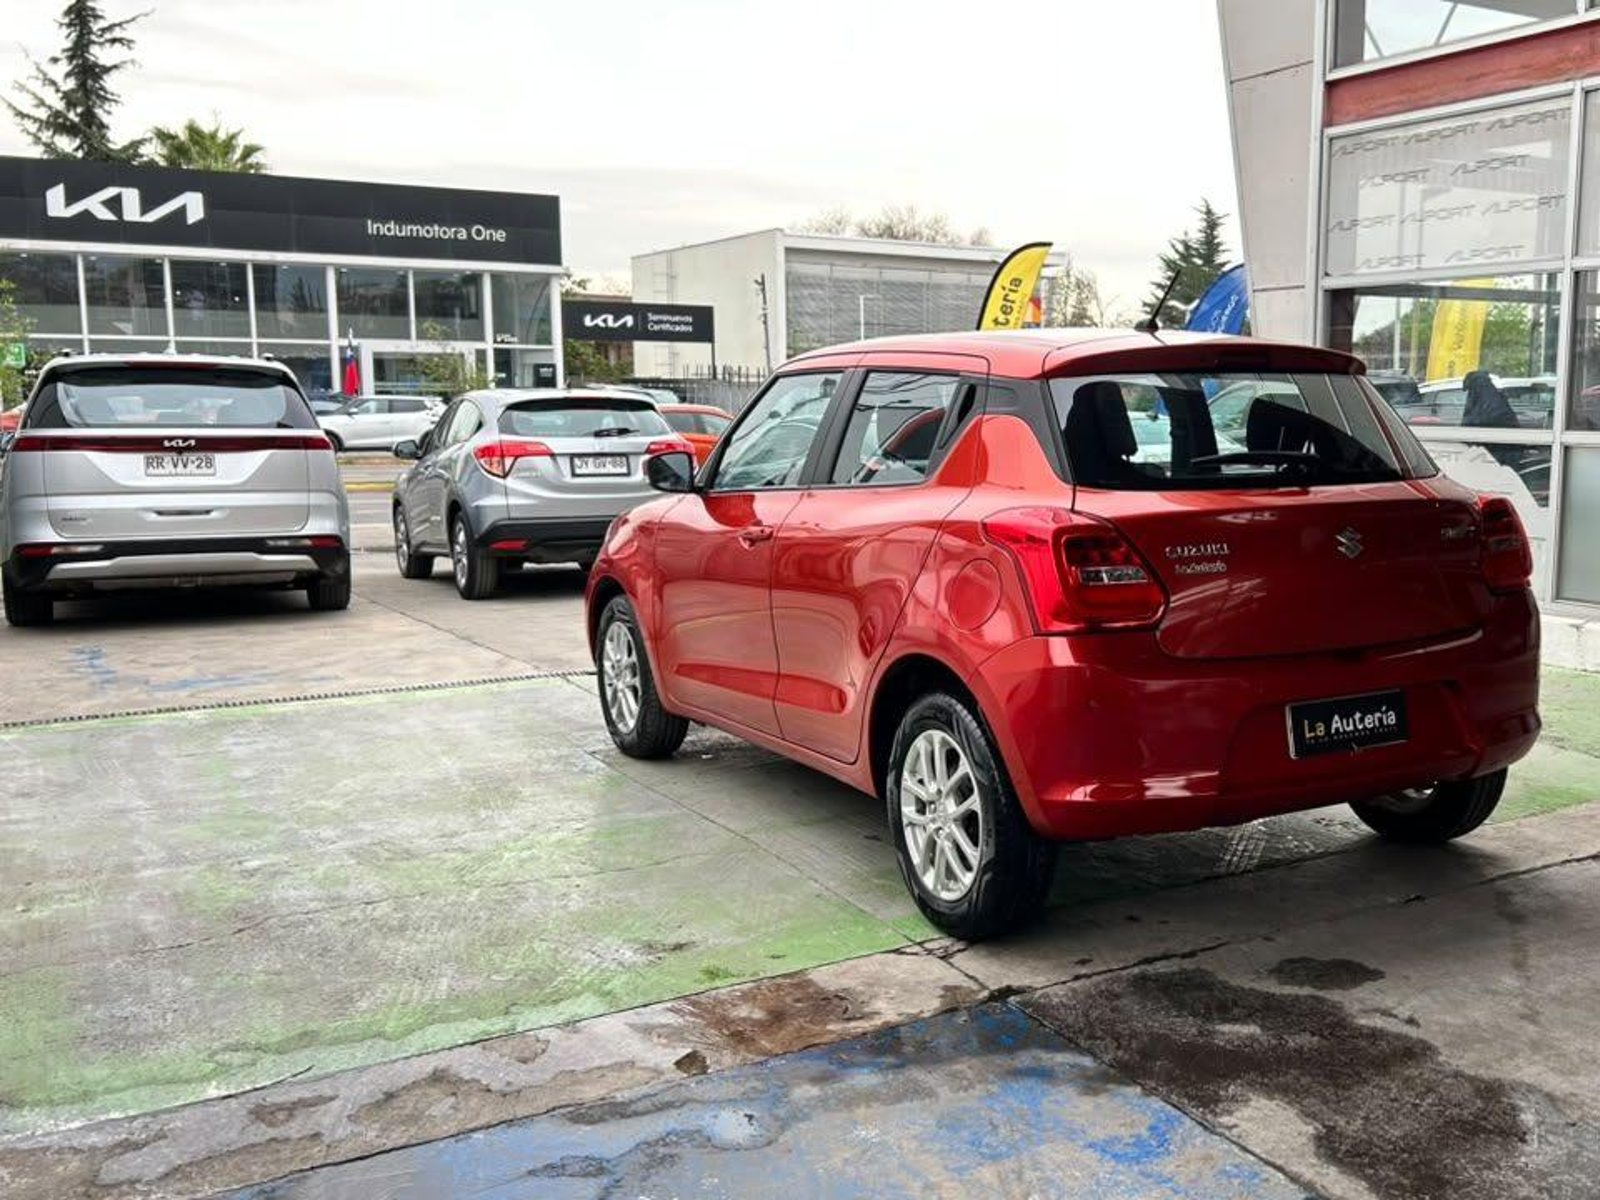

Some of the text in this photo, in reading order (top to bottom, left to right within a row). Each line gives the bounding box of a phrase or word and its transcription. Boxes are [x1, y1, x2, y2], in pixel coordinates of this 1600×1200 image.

[366, 218, 507, 242] Indumotora One
[1303, 719, 1326, 738] La
[1331, 705, 1396, 734] Autería
